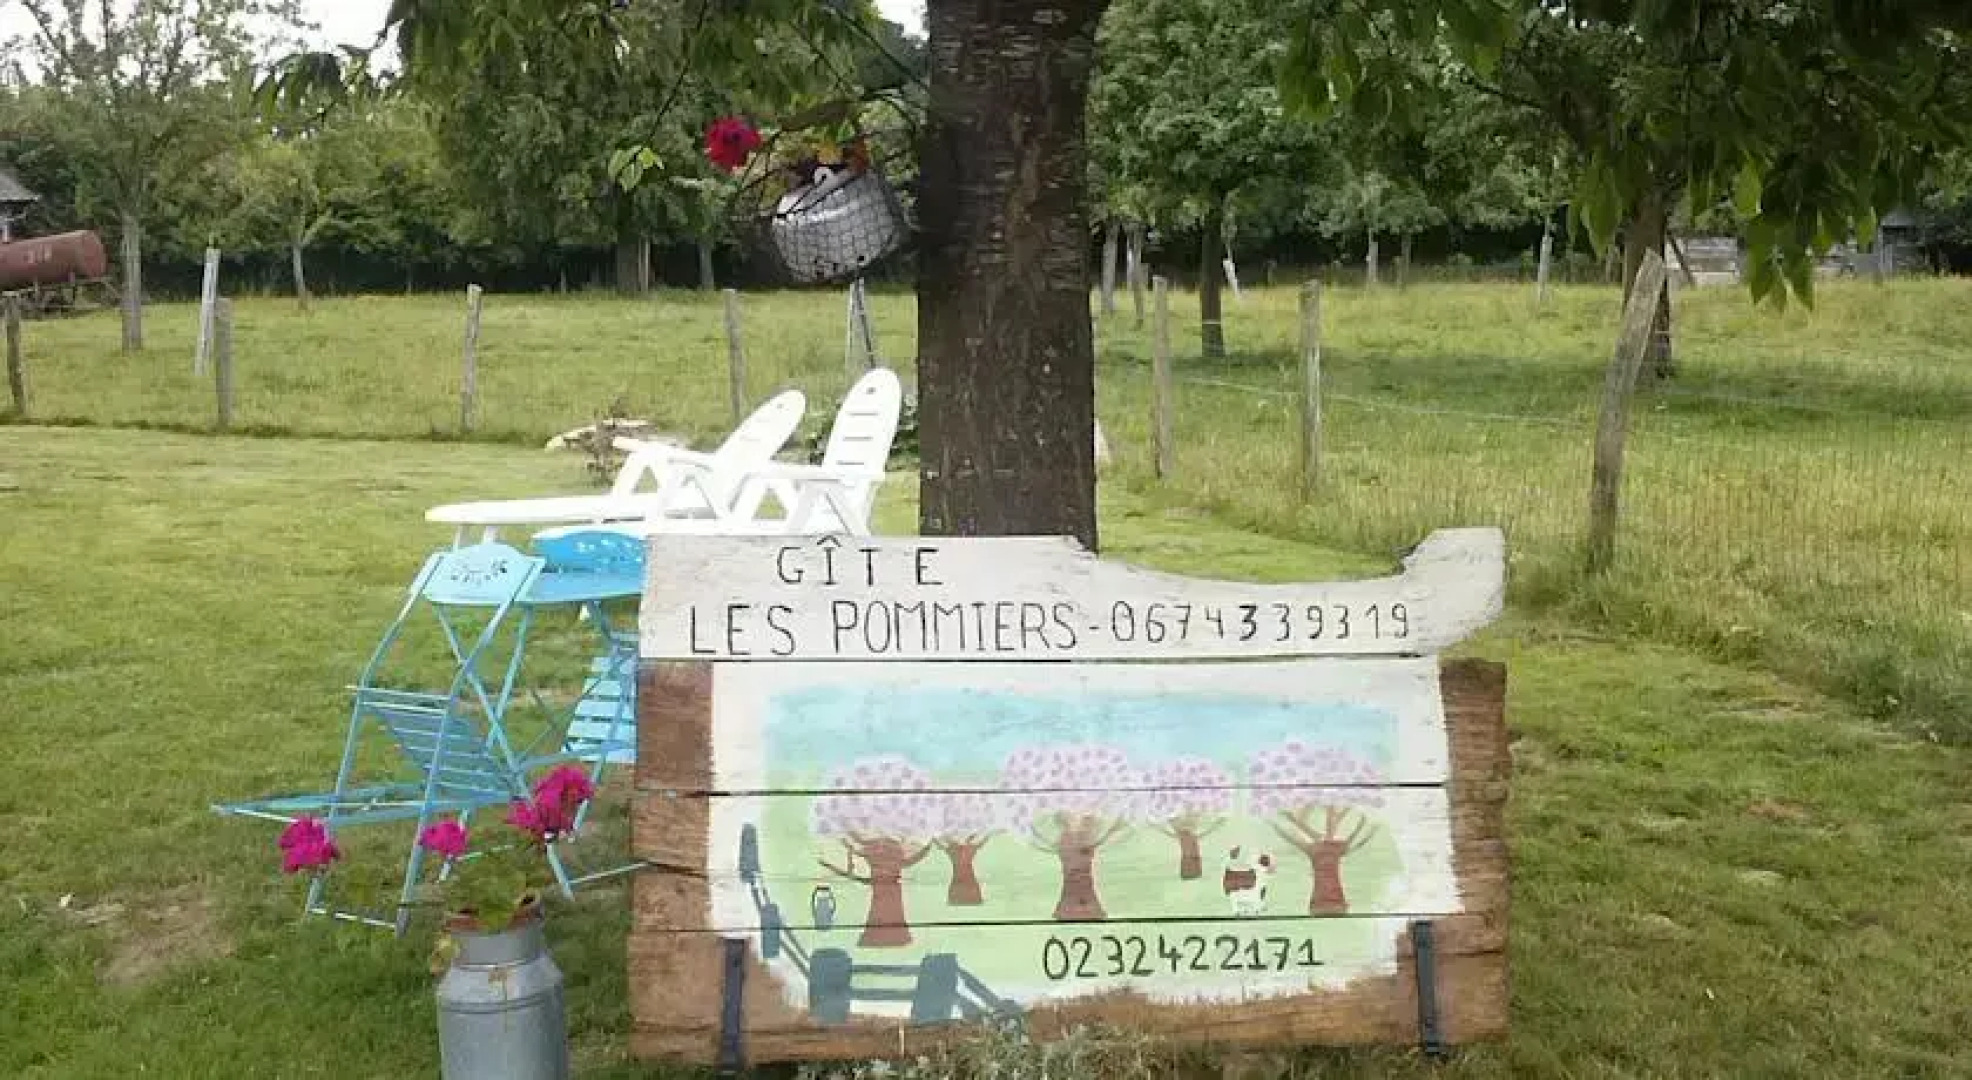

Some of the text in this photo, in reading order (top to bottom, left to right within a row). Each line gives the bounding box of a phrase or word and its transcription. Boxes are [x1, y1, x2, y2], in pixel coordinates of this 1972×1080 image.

[776, 534, 943, 586] GÎTE
[689, 604, 796, 656] LES
[1043, 934, 1325, 980] 0232422171
